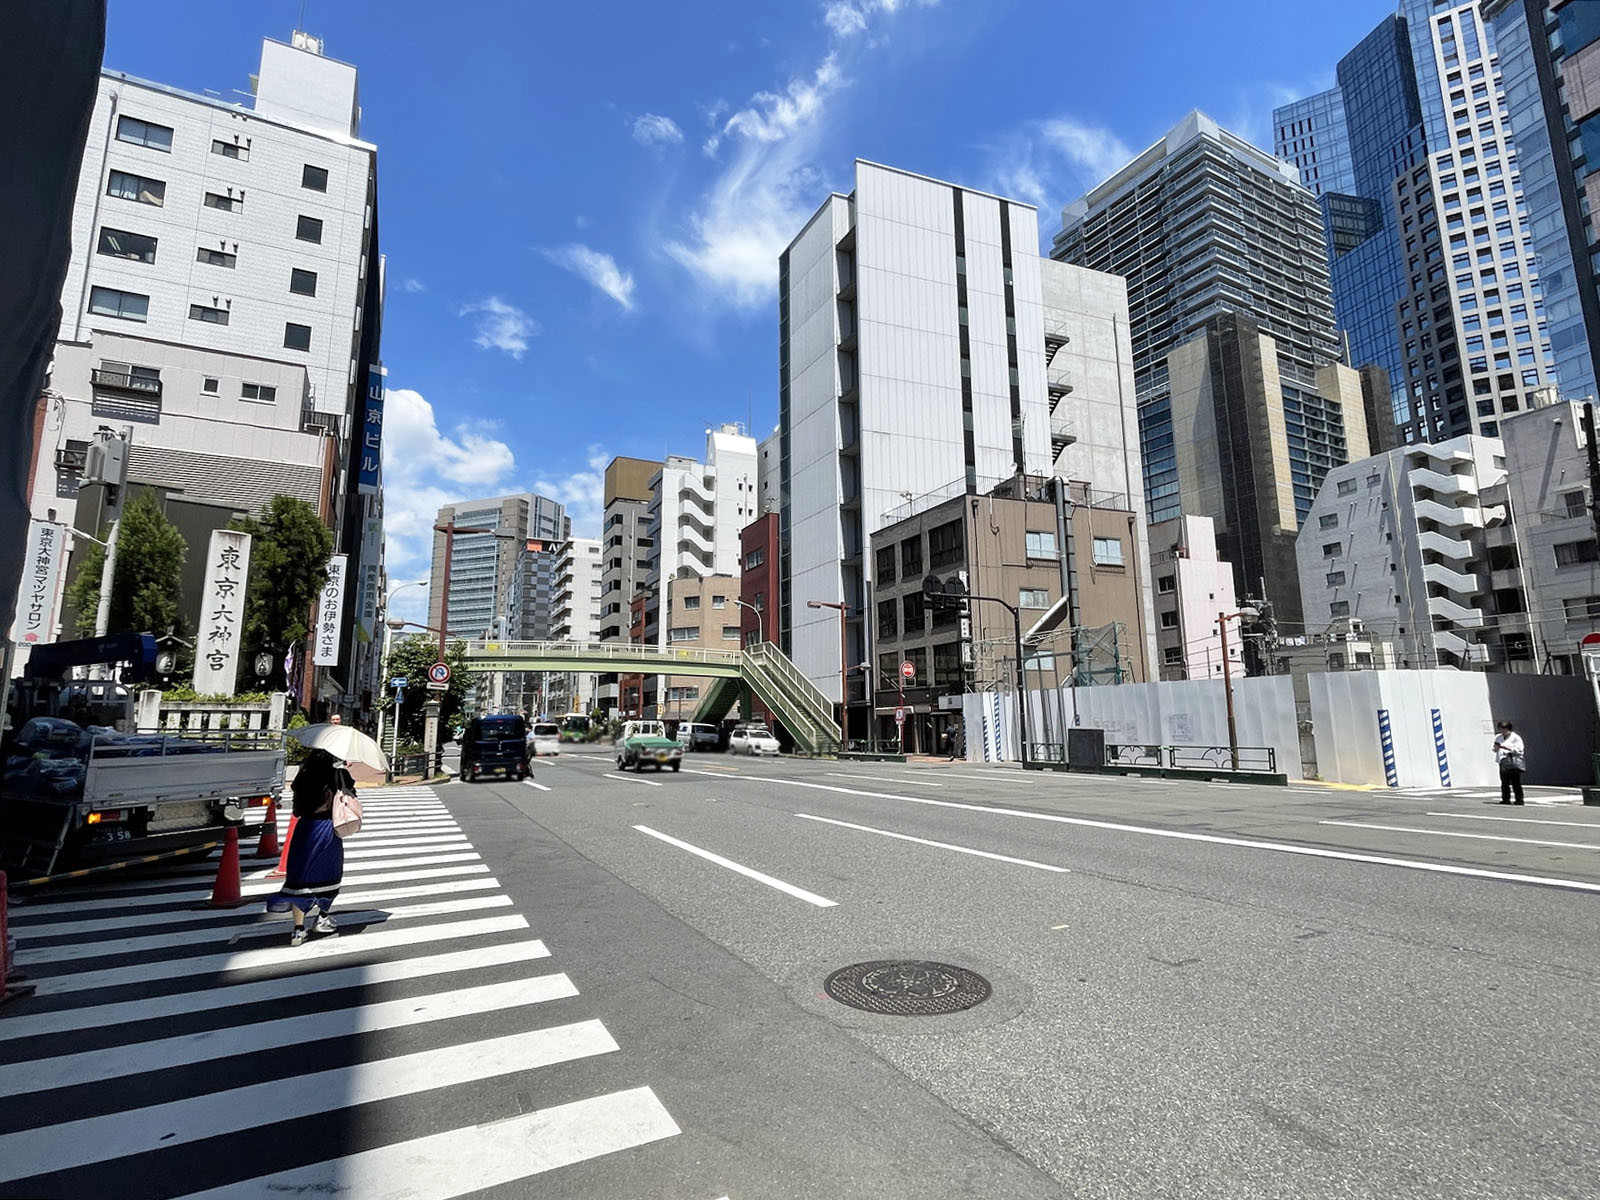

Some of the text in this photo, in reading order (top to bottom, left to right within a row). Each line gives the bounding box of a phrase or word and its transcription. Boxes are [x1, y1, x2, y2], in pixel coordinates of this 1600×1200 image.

[362, 384, 384, 472] 山京ビル
[27, 527, 54, 630] 東京大神宮マツヤサロン
[206, 545, 241, 671] 東京大神宮
[320, 563, 341, 658] 東京のお伊勢さま
